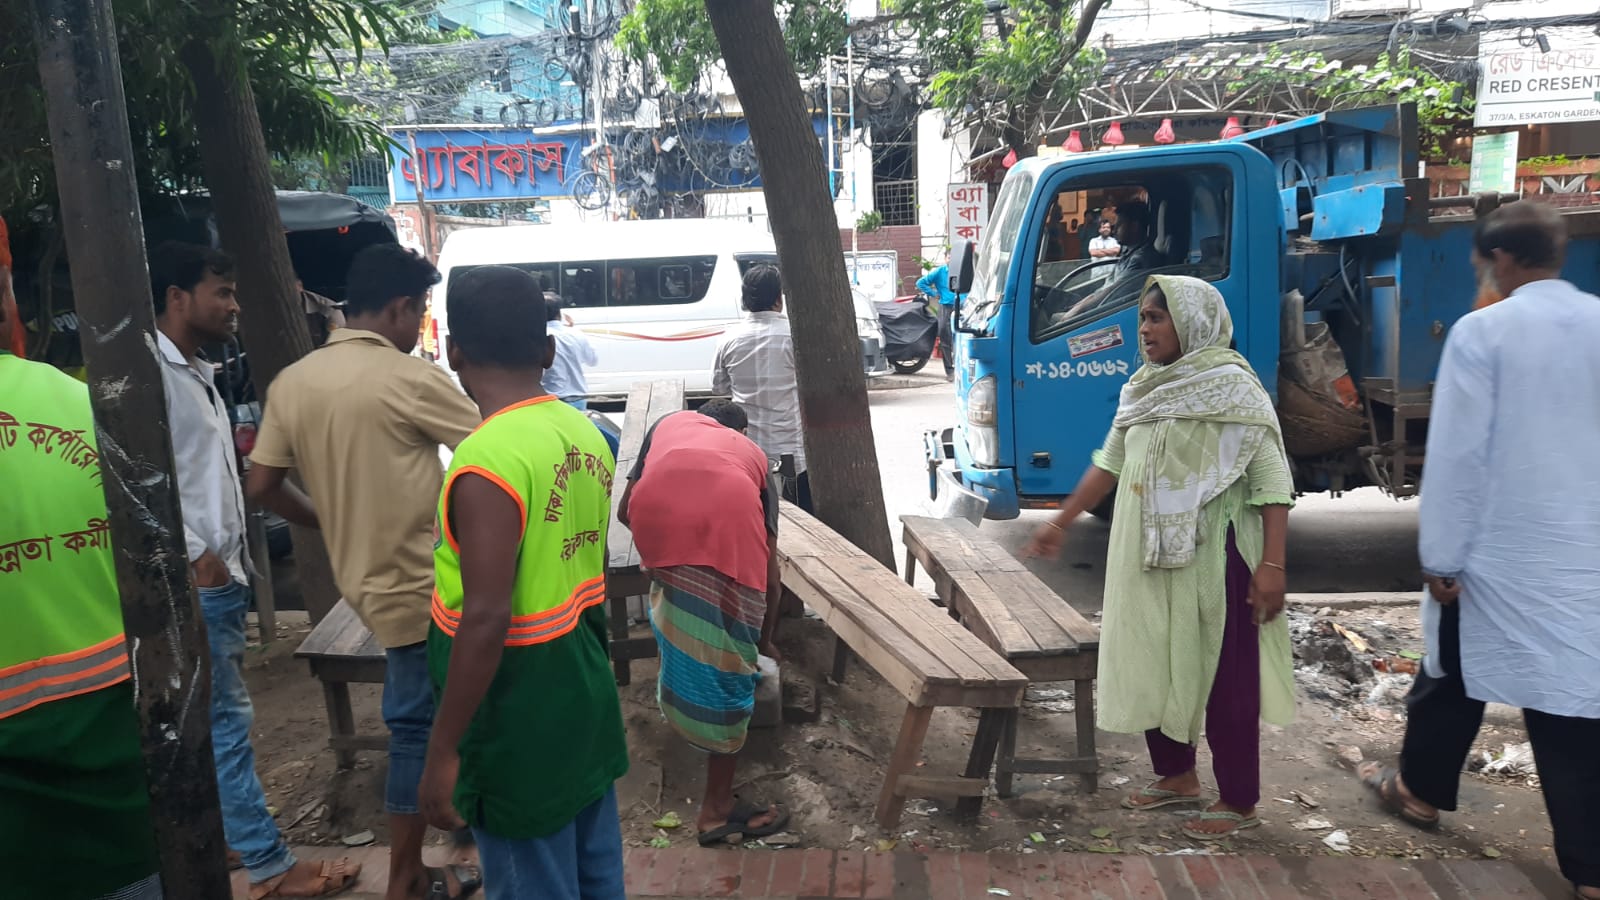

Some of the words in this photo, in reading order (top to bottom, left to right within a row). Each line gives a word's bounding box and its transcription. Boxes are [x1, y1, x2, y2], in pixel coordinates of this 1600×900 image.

[1489, 79, 1522, 94] RED
[1527, 75, 1600, 92] CRESENT
[1519, 111, 1561, 120] ESKATON
